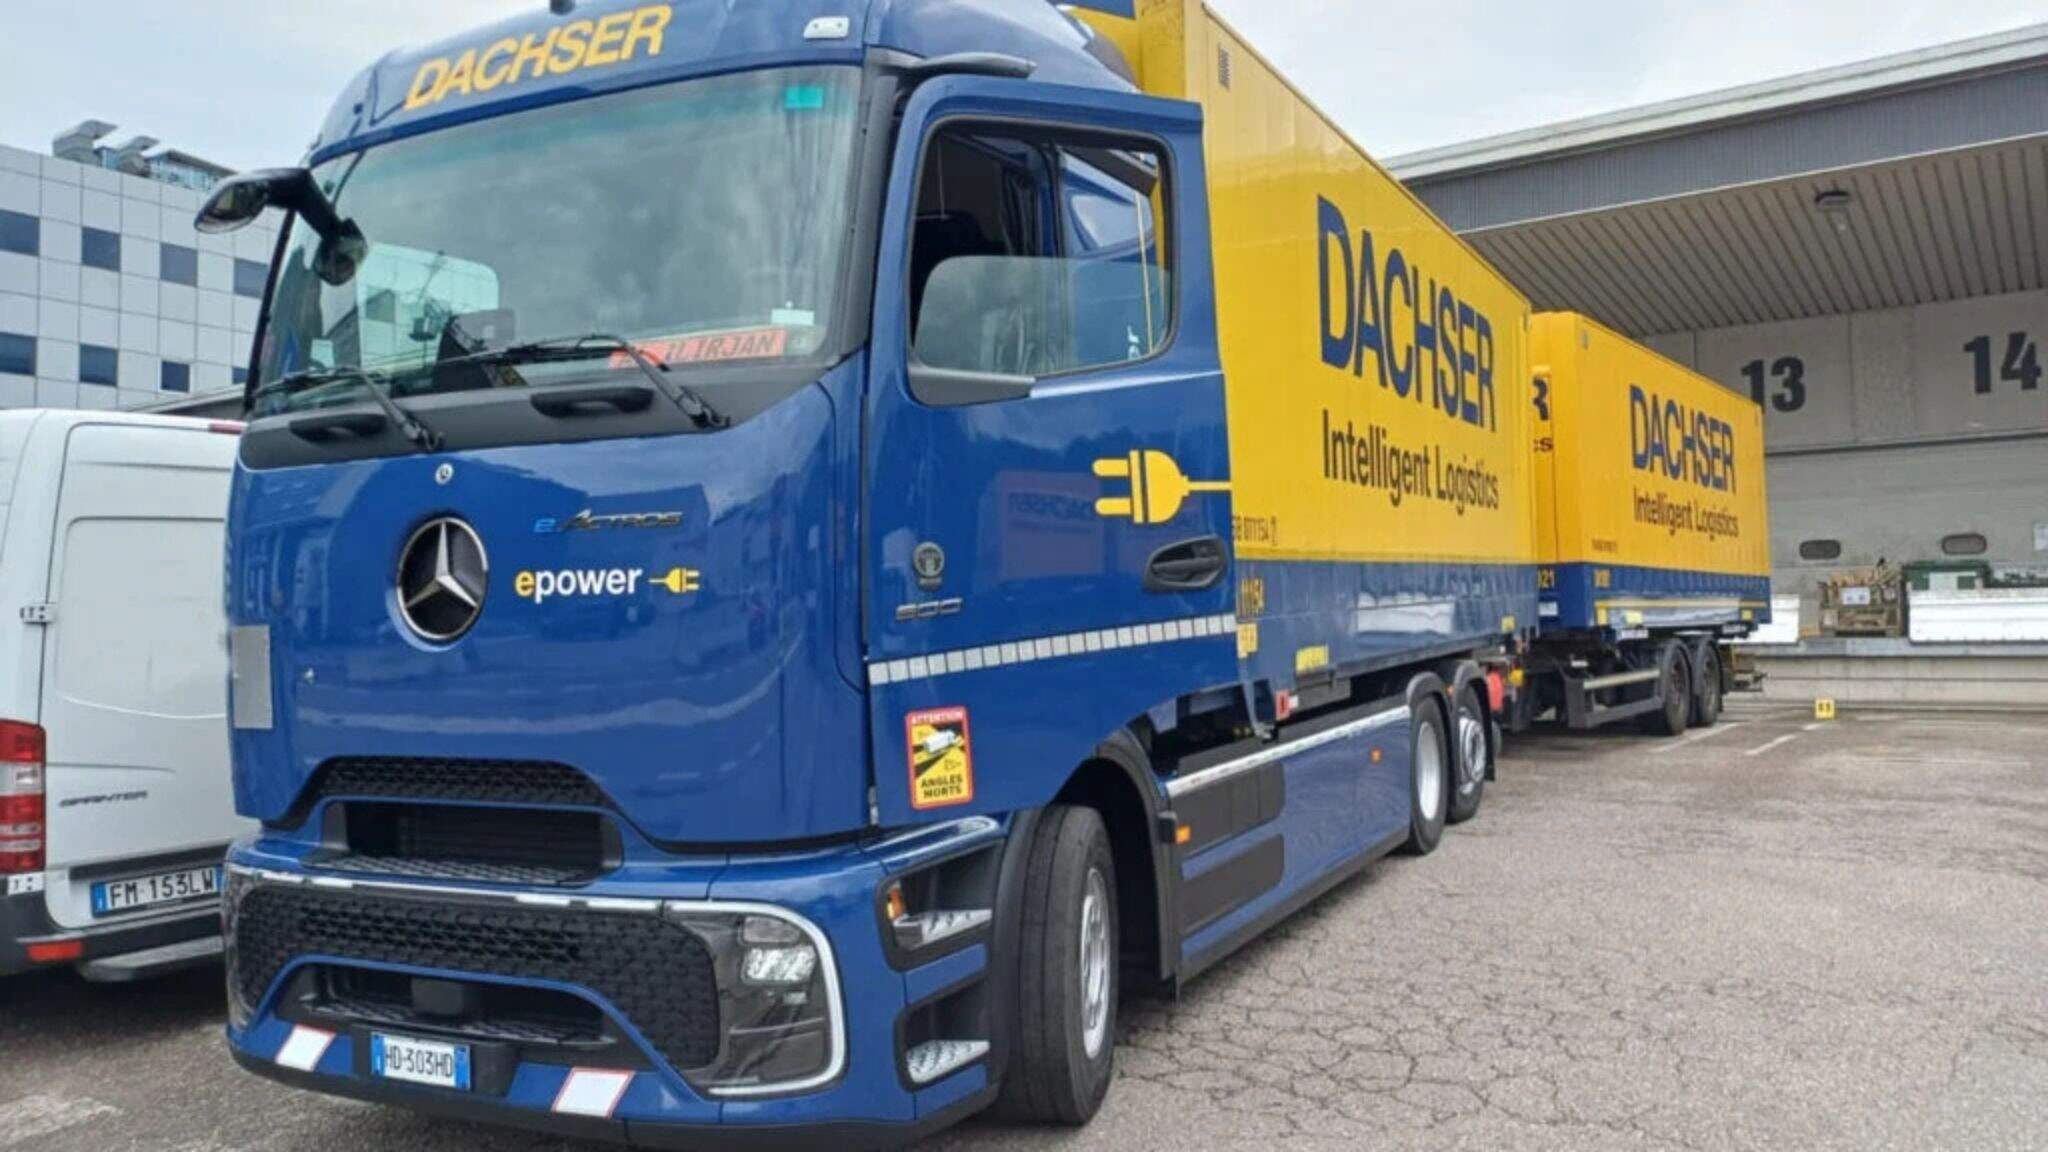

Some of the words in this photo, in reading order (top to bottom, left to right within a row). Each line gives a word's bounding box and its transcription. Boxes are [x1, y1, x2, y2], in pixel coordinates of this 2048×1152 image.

[403, 4, 673, 110] DACHSER
[1317, 193, 1497, 433] DACHSER
[1740, 356, 1806, 414] 13
[1963, 331, 2042, 394] 14
[1322, 408, 1431, 508] Intelligent
[1435, 445, 1499, 516] Logistics
[1629, 384, 1737, 494] DACHSER
[1633, 485, 1693, 536] Intelligent
[1695, 501, 1740, 541] Logistics
[515, 567, 643, 604] epower
[920, 773, 963, 788] ANGLES
[923, 785, 963, 799] MORTS
[109, 881, 139, 907] FM
[149, 869, 215, 900] 153LW
